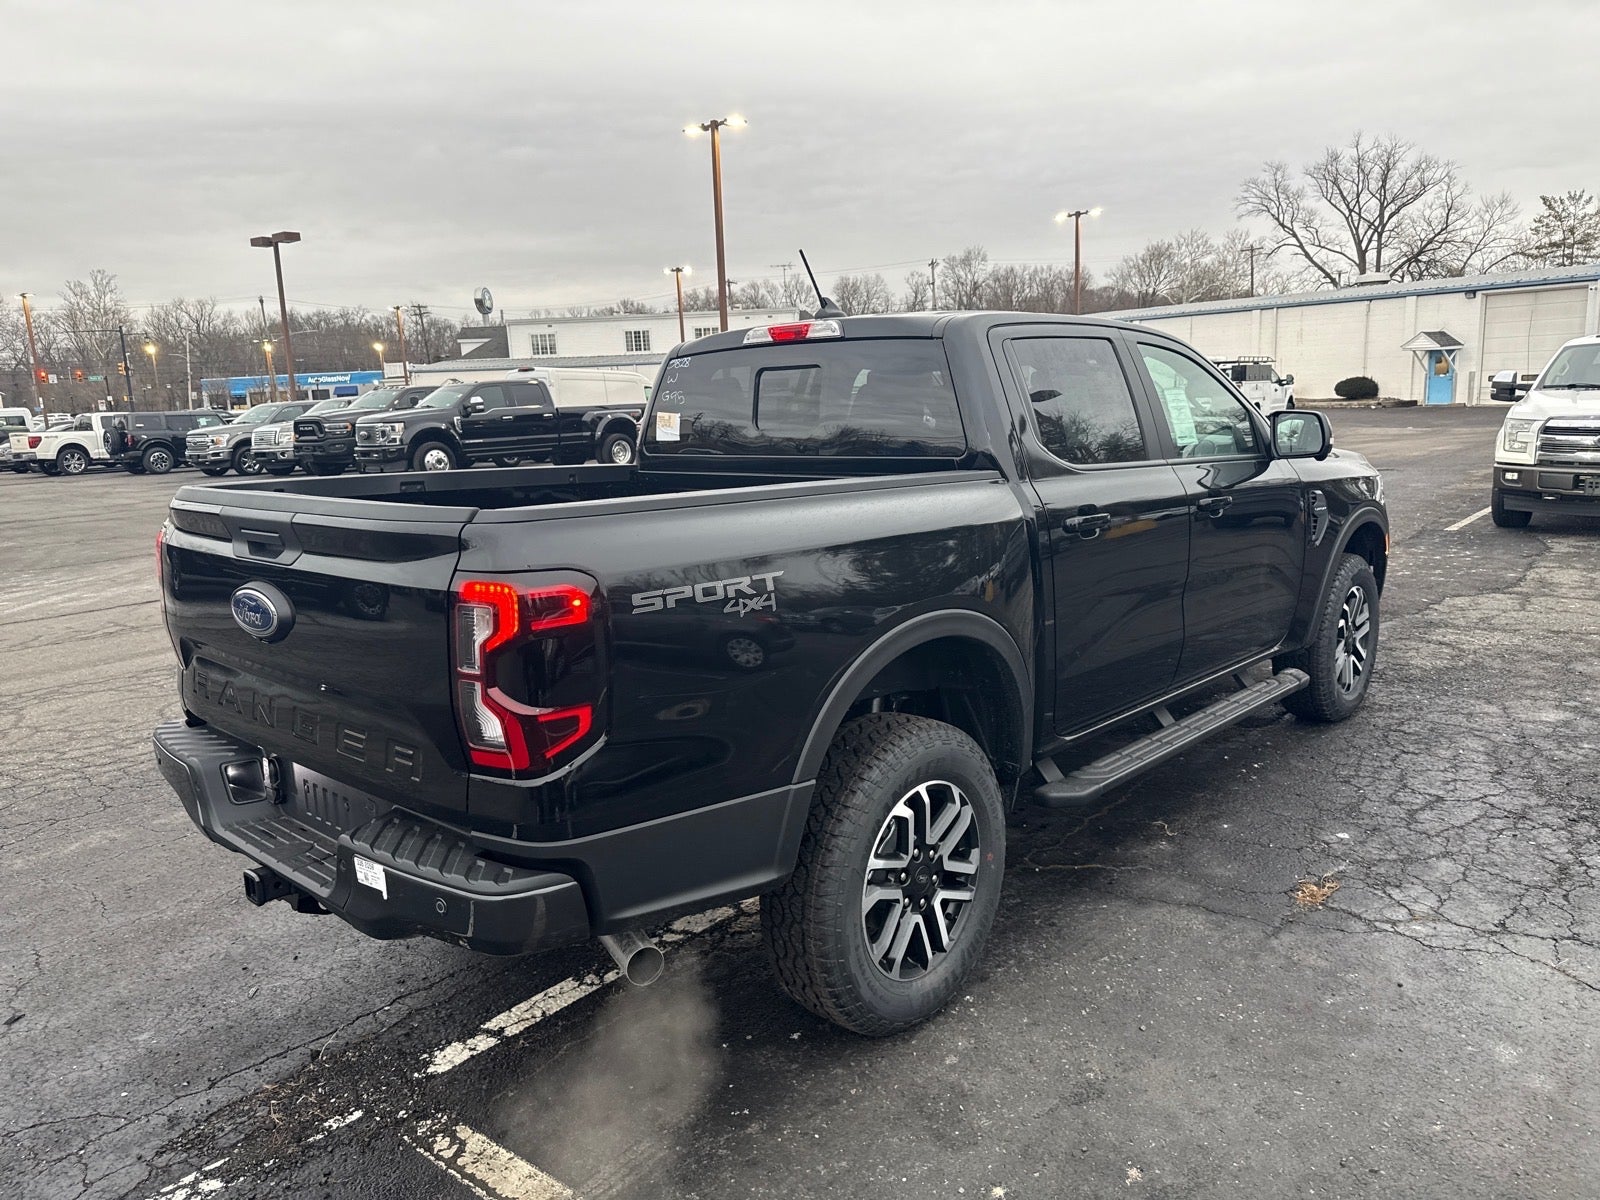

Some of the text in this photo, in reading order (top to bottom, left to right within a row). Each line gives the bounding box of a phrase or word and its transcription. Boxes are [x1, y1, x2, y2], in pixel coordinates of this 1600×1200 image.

[667, 372, 679, 384] W
[631, 570, 785, 615] SPORT
[237, 597, 264, 626] Ford
[192, 667, 423, 782] RANGER
